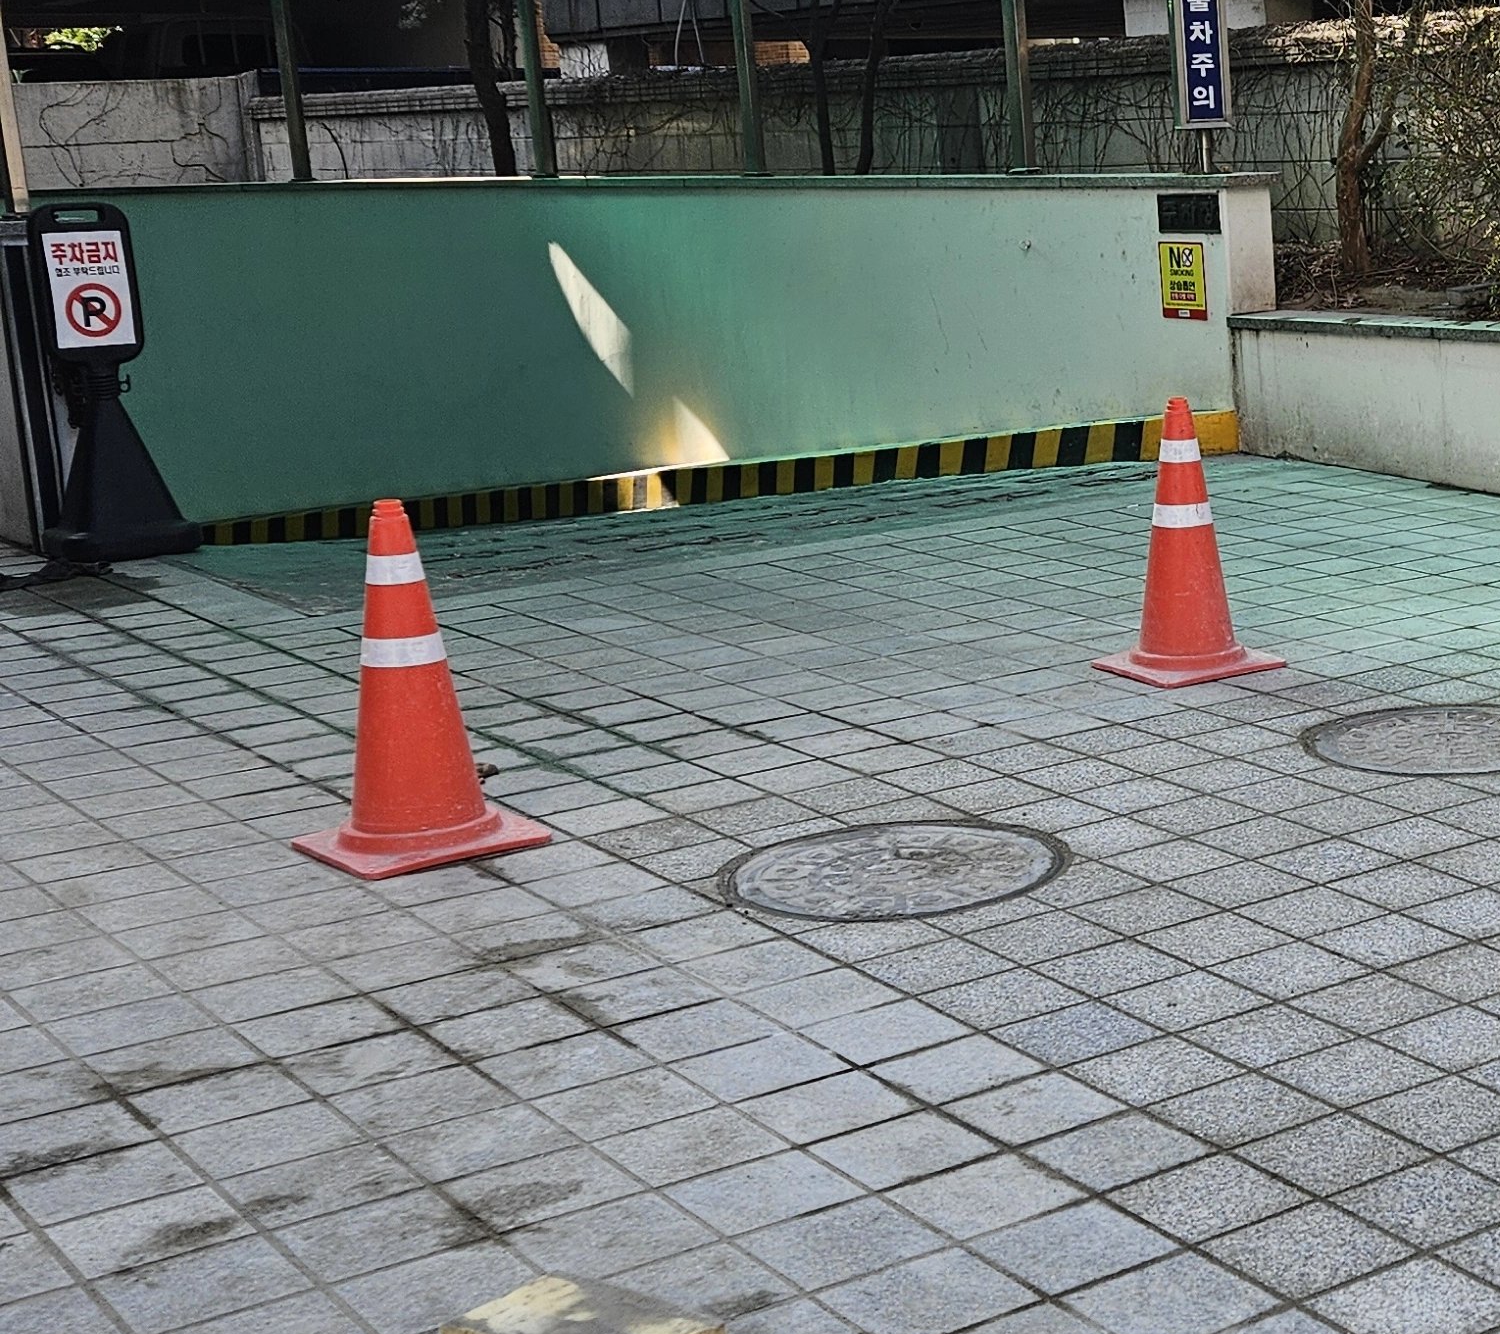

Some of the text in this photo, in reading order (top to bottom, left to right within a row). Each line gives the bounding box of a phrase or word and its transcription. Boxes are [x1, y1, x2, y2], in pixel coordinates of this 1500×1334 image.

[51, 241, 118, 265] 주차금지
[1169, 246, 1193, 268] NO
[55, 265, 120, 277] 협조 부탁드립니다
